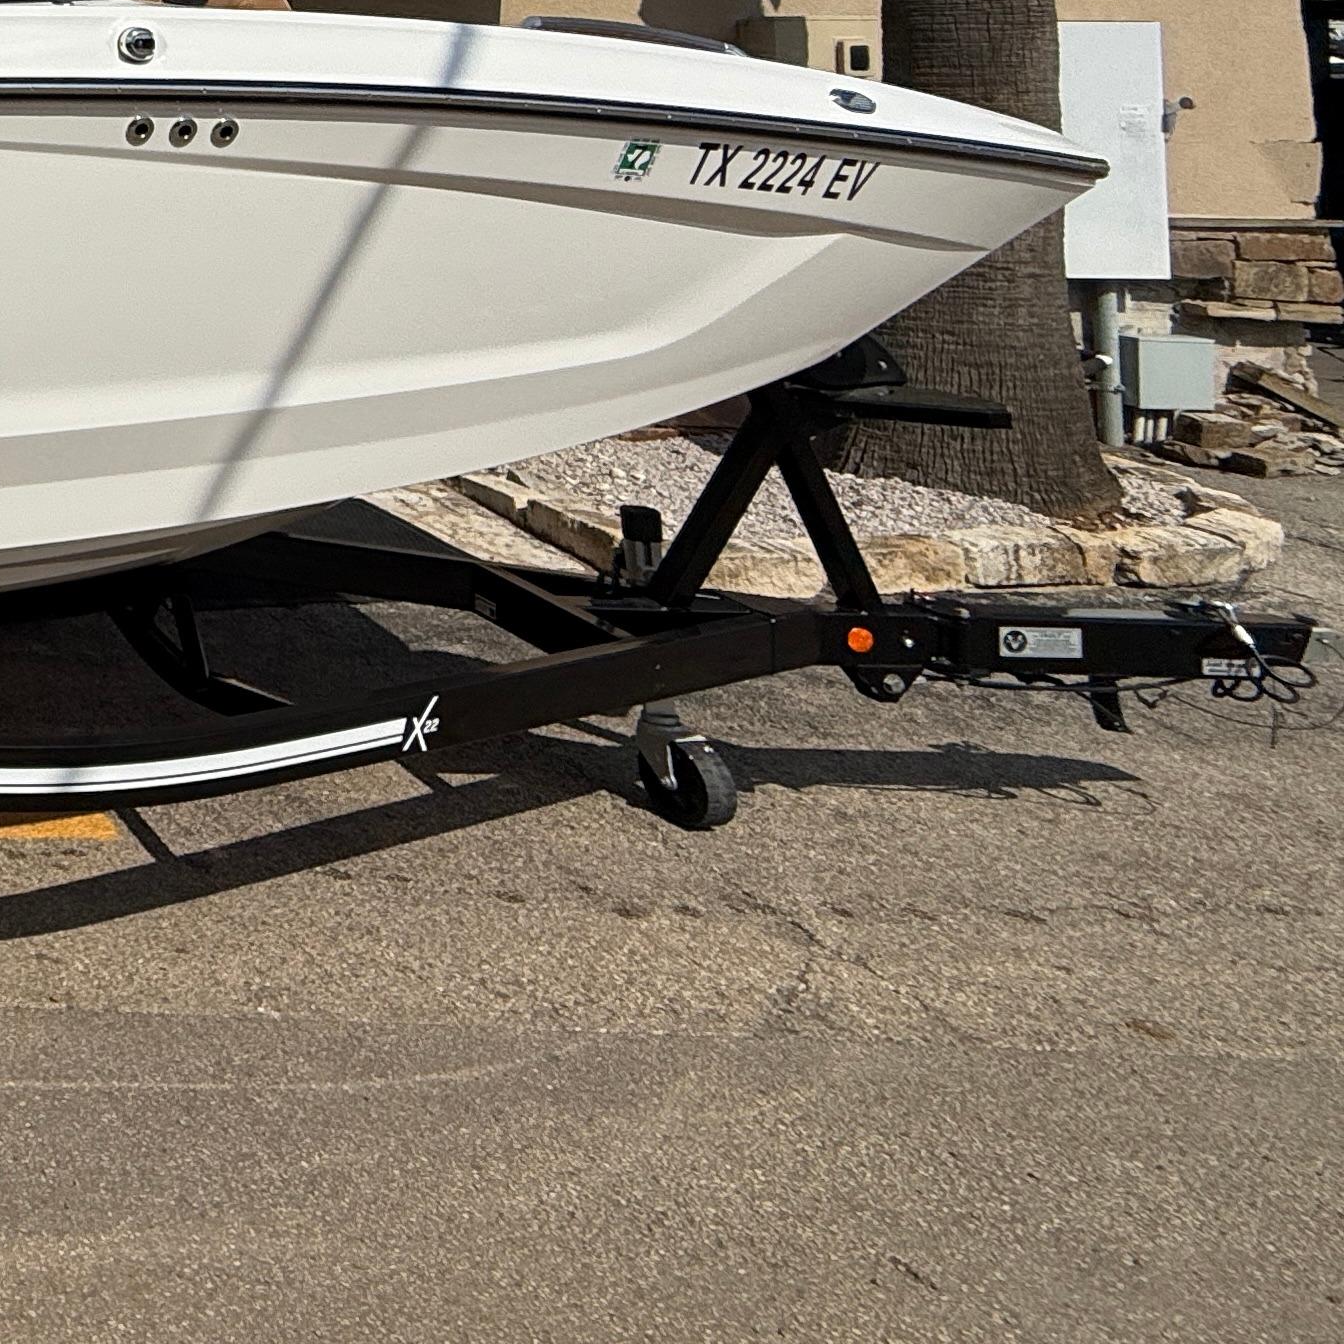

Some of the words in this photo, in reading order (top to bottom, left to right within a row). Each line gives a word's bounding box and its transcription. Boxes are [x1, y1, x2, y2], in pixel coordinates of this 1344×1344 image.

[689, 142, 744, 187] TX
[738, 147, 828, 196] 2224
[822, 158, 881, 201] EV
[402, 695, 440, 752] X22
